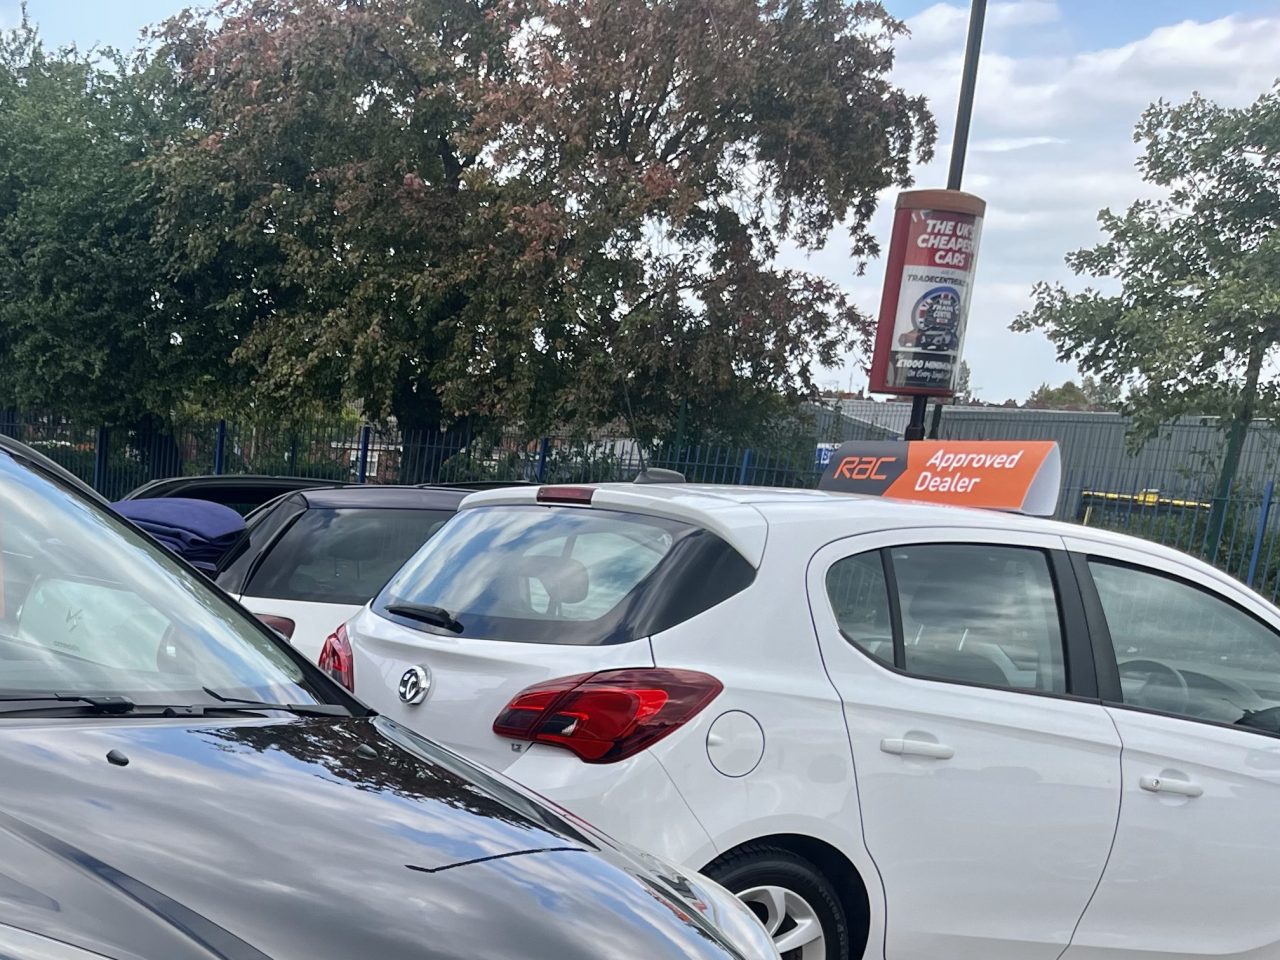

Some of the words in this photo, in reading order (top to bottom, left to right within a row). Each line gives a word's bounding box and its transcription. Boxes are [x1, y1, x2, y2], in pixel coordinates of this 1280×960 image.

[926, 220, 955, 234] THE
[934, 251, 966, 266] CARS
[926, 449, 1024, 472] Approved
[914, 471, 981, 493] Dealer
